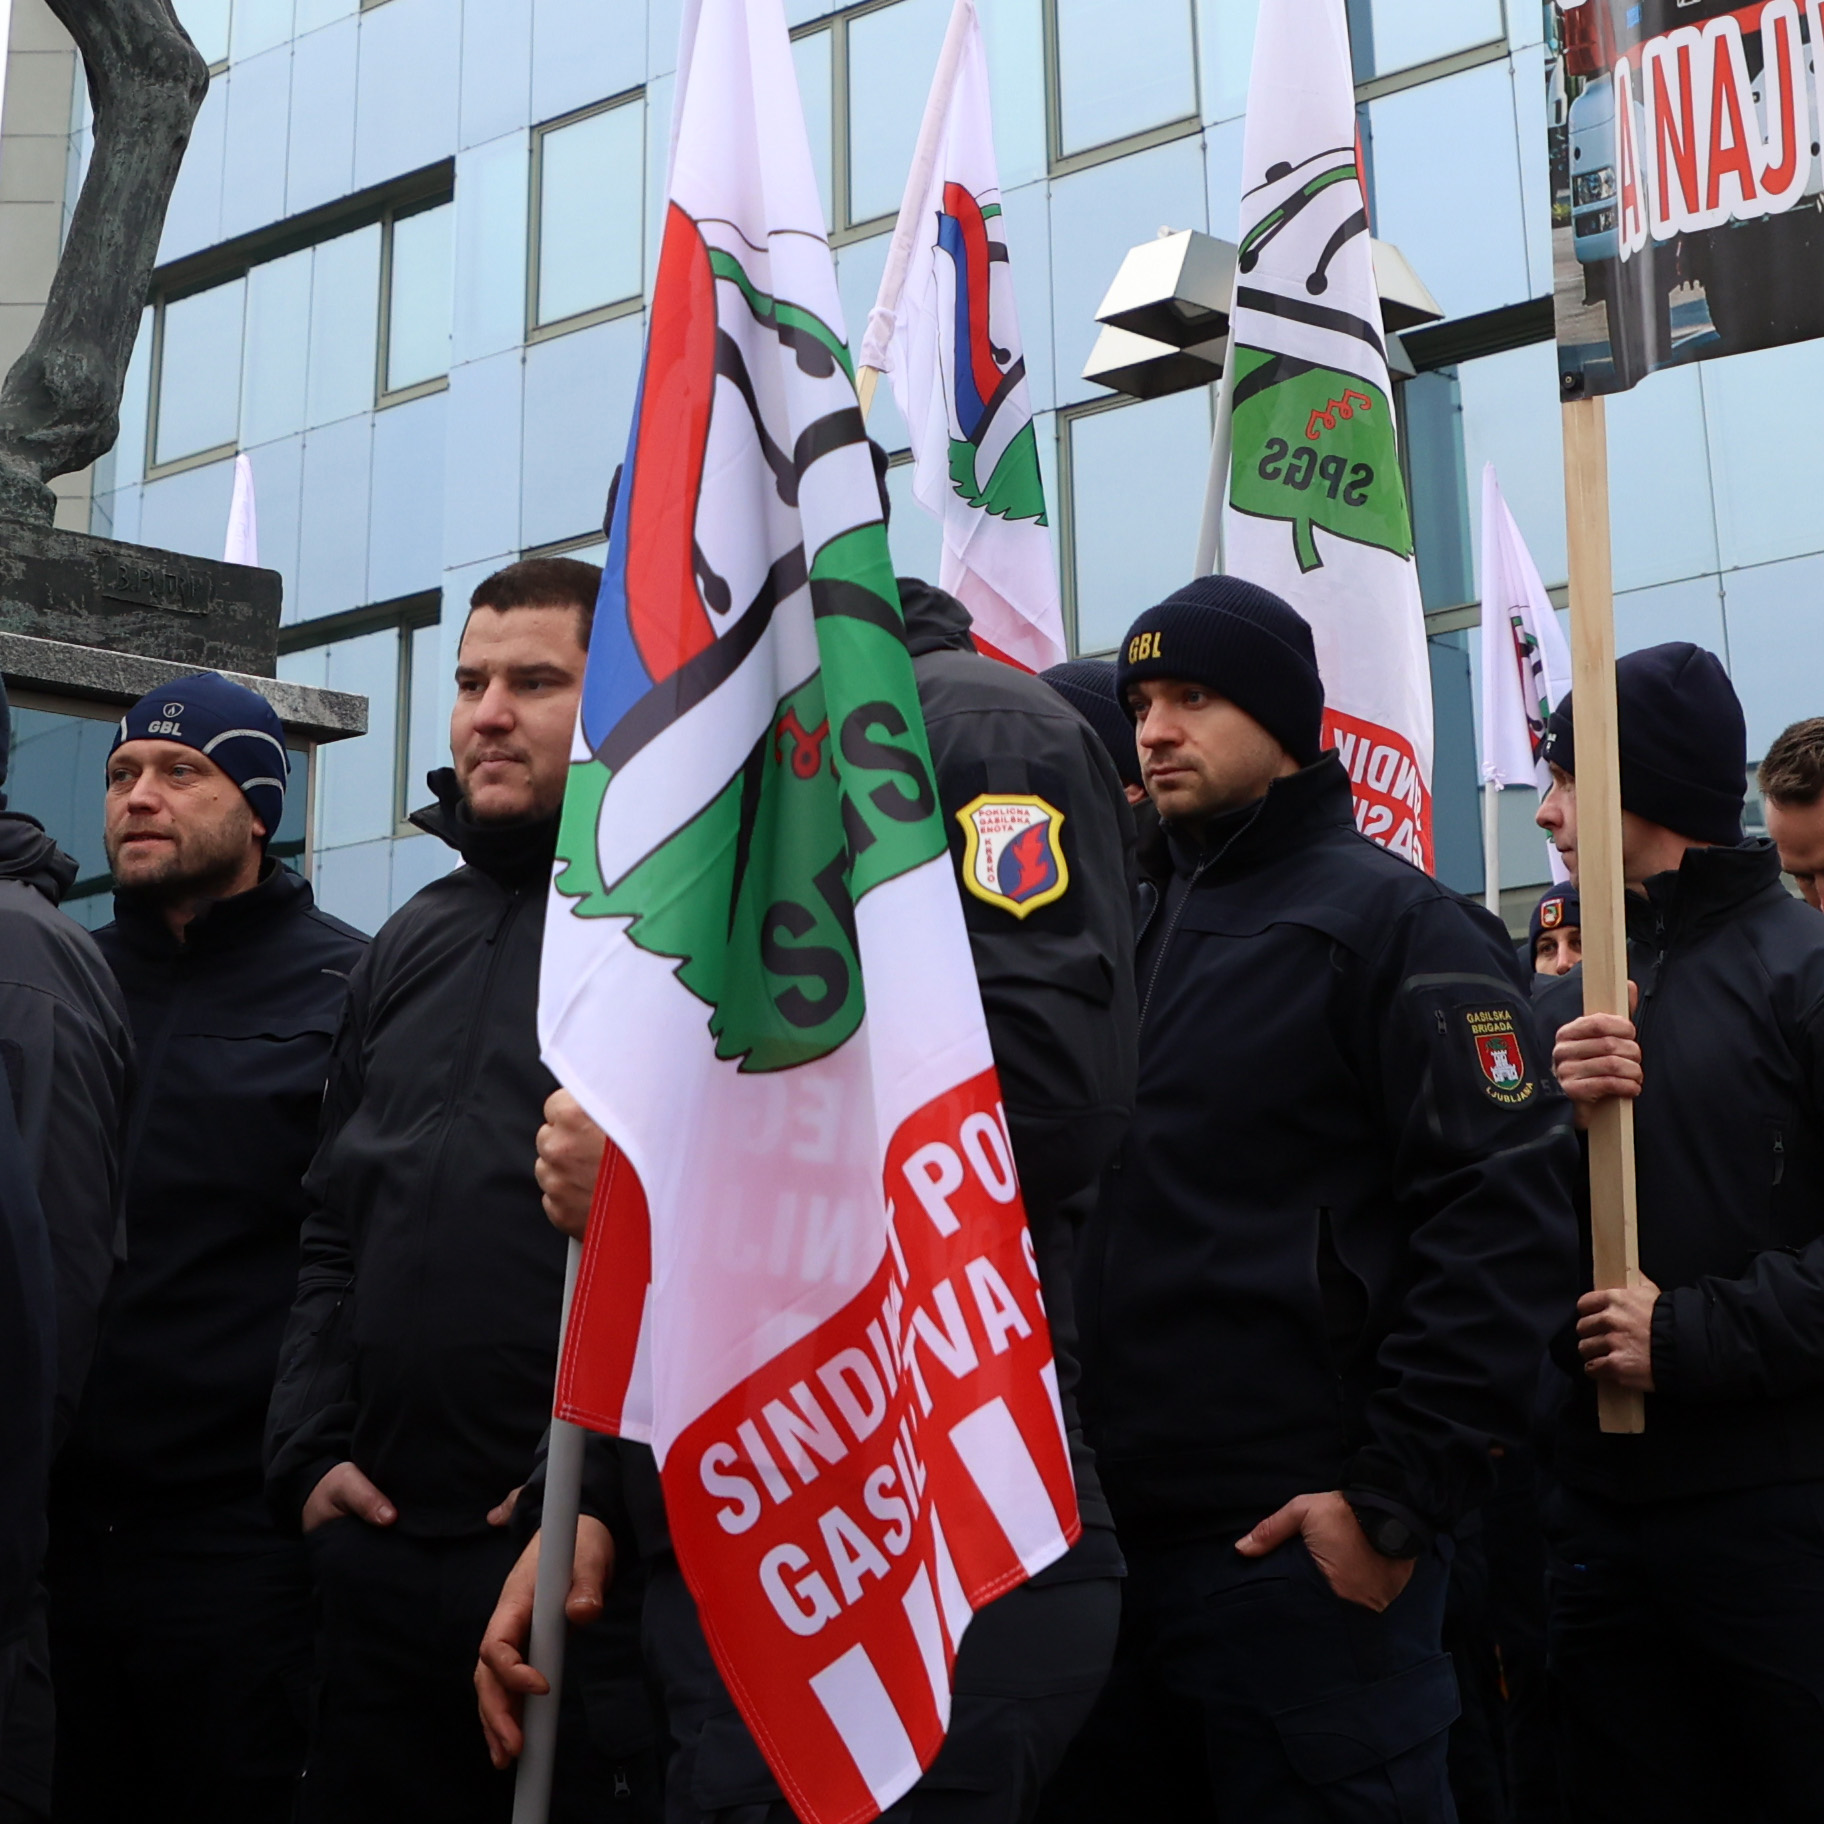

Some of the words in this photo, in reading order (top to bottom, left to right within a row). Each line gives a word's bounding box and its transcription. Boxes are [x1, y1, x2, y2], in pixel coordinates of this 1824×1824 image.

[1617, 72, 1643, 246] A
[1650, 14, 1799, 223] NAJ
[1128, 631, 1162, 665] GBL
[147, 720, 182, 736] GBL
[1466, 1010, 1513, 1024] GASILSKA
[1471, 1021, 1514, 1034] BRIGADA
[1485, 1081, 1534, 1104] LJUBLJANA
